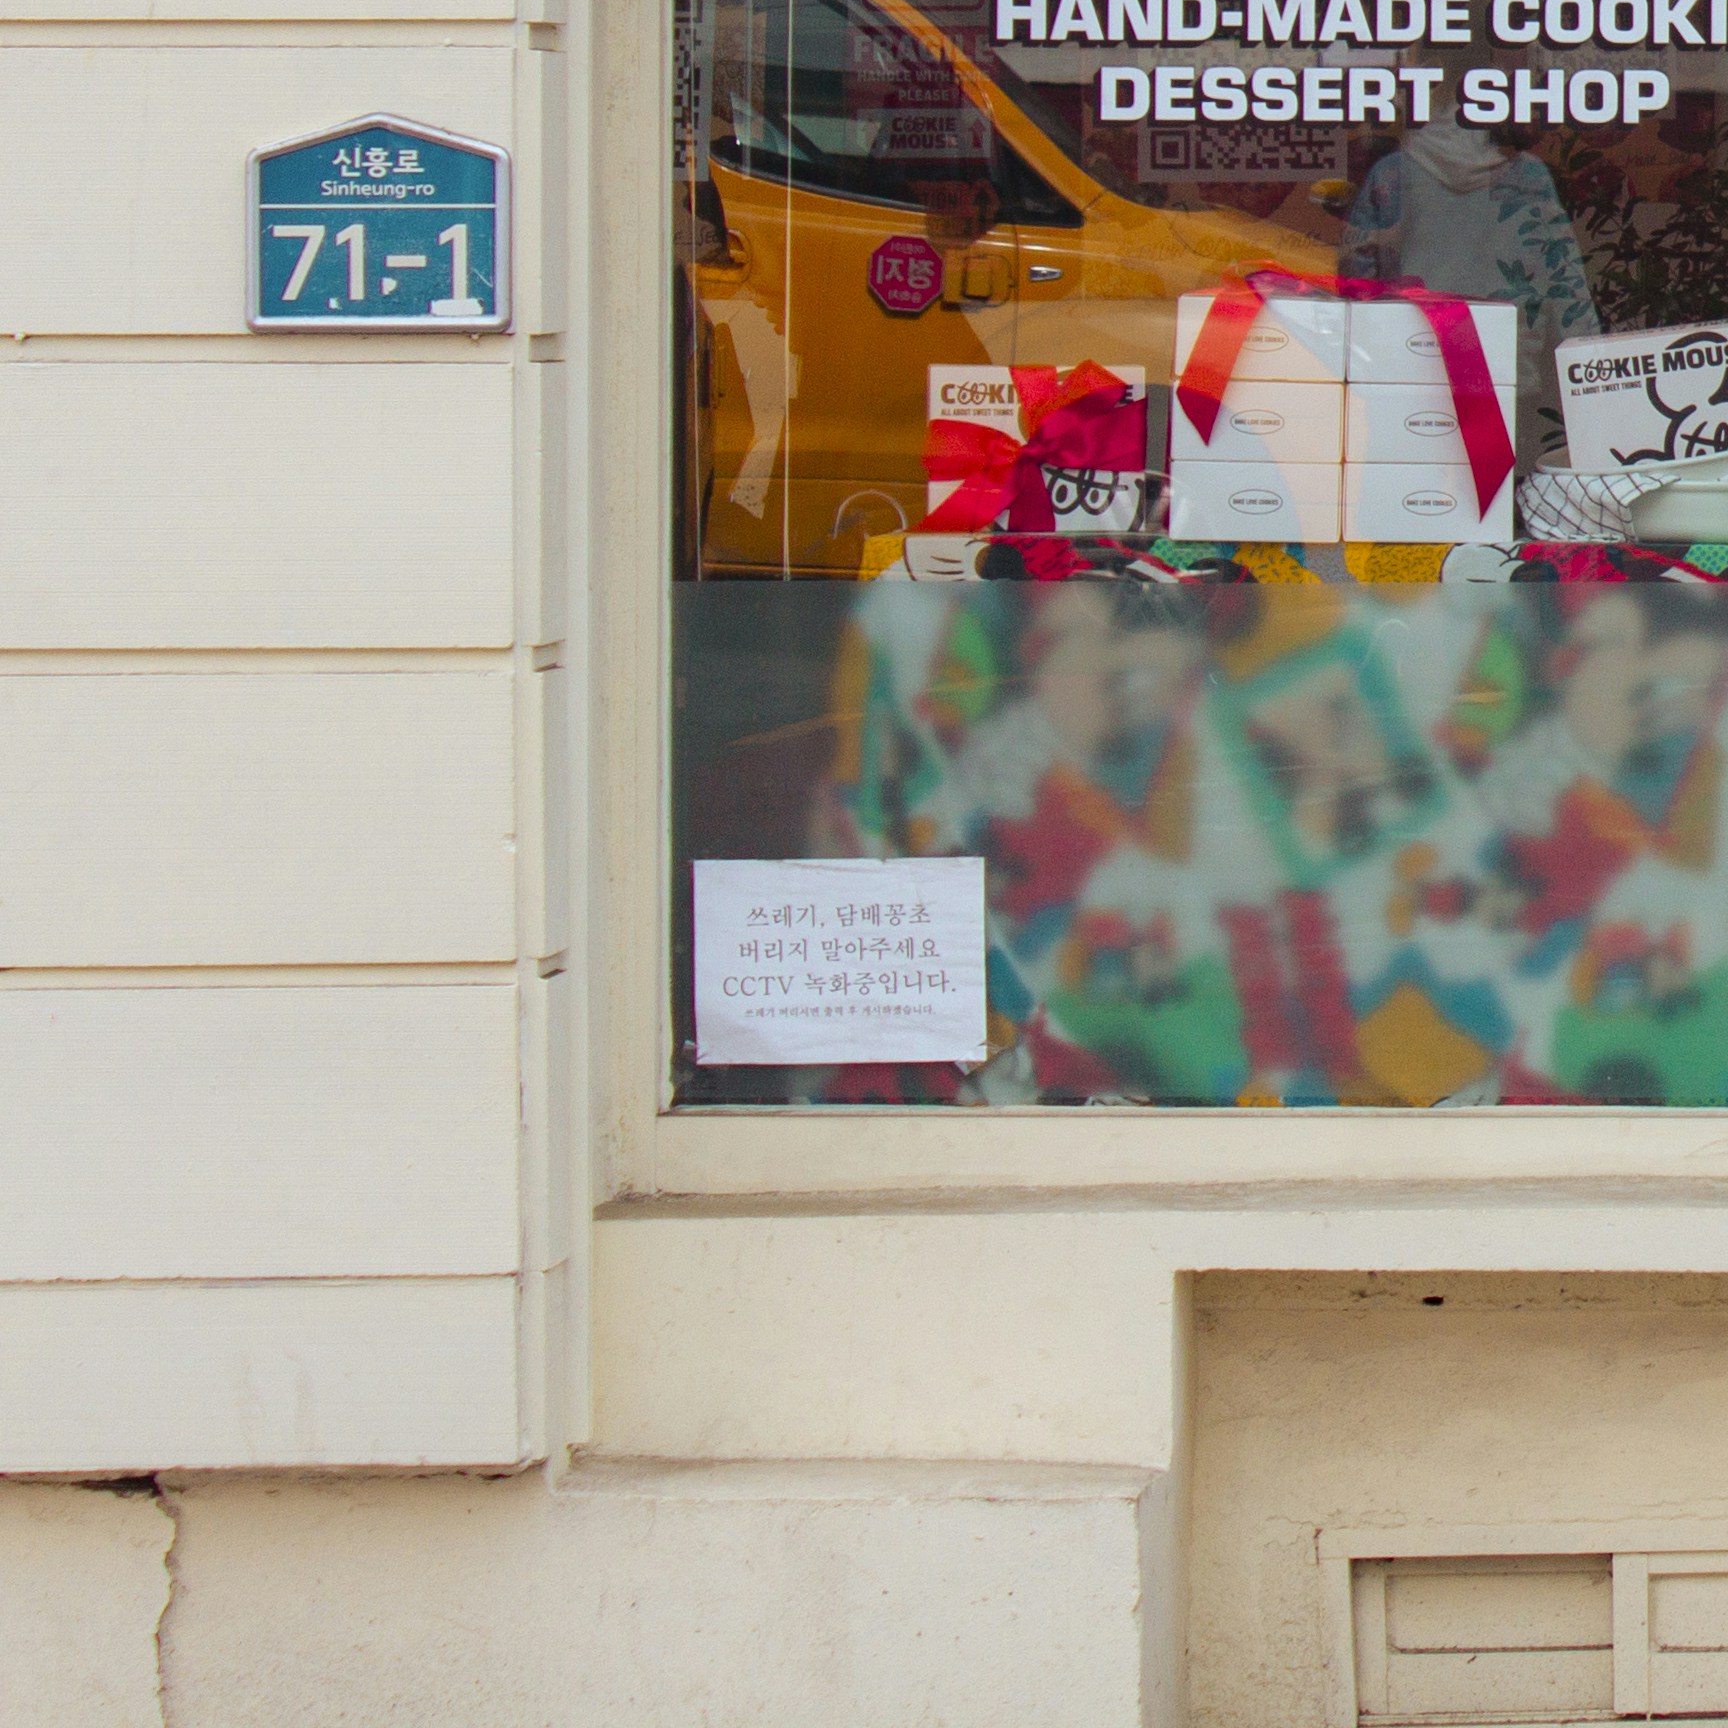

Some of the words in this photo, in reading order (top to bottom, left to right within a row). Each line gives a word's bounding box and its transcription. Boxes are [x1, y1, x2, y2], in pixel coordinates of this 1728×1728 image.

[1100, 66, 1443, 123] DESSERT
[1461, 68, 1671, 125] SHOP
[892, 117, 957, 132] COOKIE
[332, 147, 424, 178] 신흥로
[321, 181, 435, 198] Sinheung-ro
[272, 223, 469, 301] 71-1
[1568, 354, 1657, 384] COOKIE
[941, 382, 1021, 405] COOKI
[1571, 388, 1581, 396] ALL
[1582, 385, 1600, 395] ABOUT
[1602, 383, 1620, 393] SWEET
[1621, 381, 1642, 391] THINGS
[746, 904, 825, 928] 쓰레기,
[836, 903, 931, 927] 담배꽁초
[738, 938, 808, 963] 버리지
[821, 937, 940, 962] 말아주세요
[722, 976, 795, 997] CCTV
[804, 970, 956, 996] 녹화중입니다.
